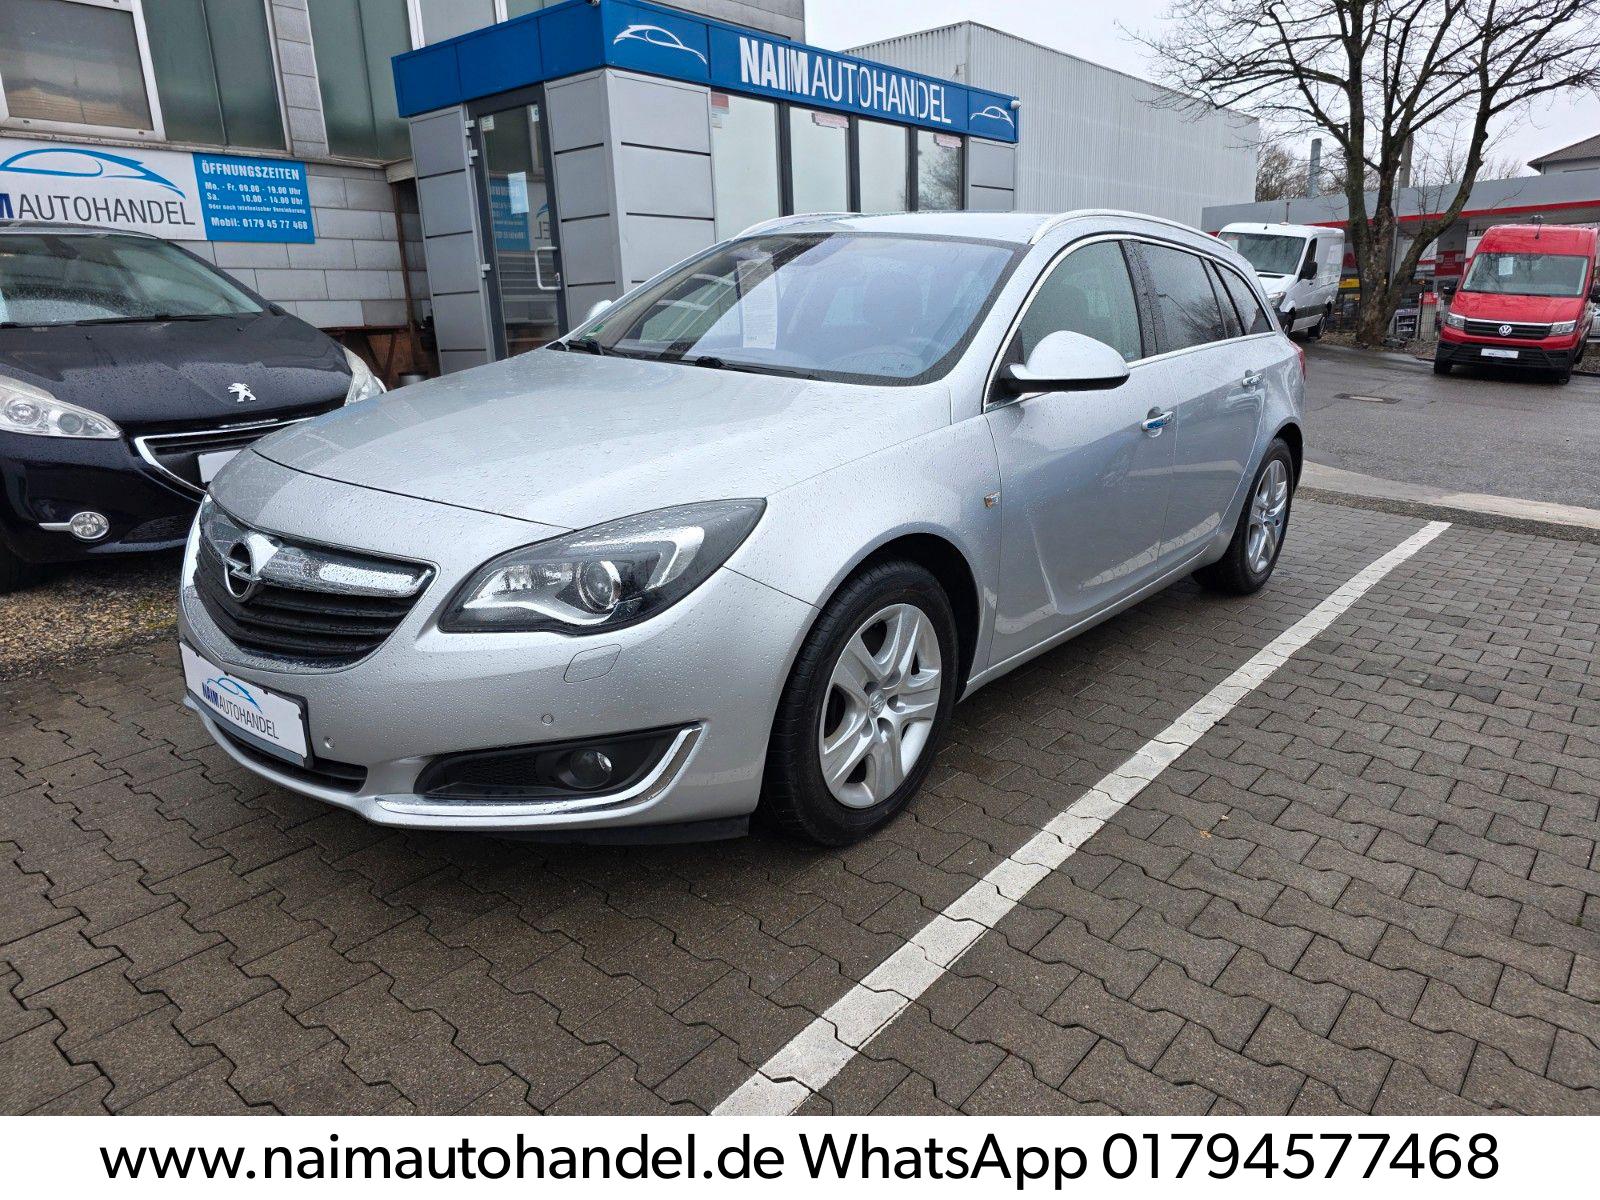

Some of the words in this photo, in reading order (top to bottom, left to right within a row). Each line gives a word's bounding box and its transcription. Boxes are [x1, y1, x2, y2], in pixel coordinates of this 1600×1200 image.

[739, 37, 810, 96] NAIM
[811, 56, 952, 124] AUTOHANDEL
[202, 160, 300, 181] ÖFFNUNGSZEITEN
[205, 182, 220, 190] Mo.
[227, 183, 237, 192] Fr.
[239, 184, 260, 193] 09.00
[289, 187, 301, 196] Uhr
[206, 192, 220, 201] Sa.
[242, 194, 262, 203] 10.00
[270, 196, 290, 205] 14.00
[291, 197, 303, 206] Uhr
[18, 193, 196, 226] AUTOHANDEL
[211, 217, 240, 227] Mobil:
[243, 218, 264, 228] 0179
[266, 219, 278, 229] 45
[280, 220, 290, 229] 77
[293, 221, 308, 230] 468
[219, 695, 279, 740] AUTOHANDEL
